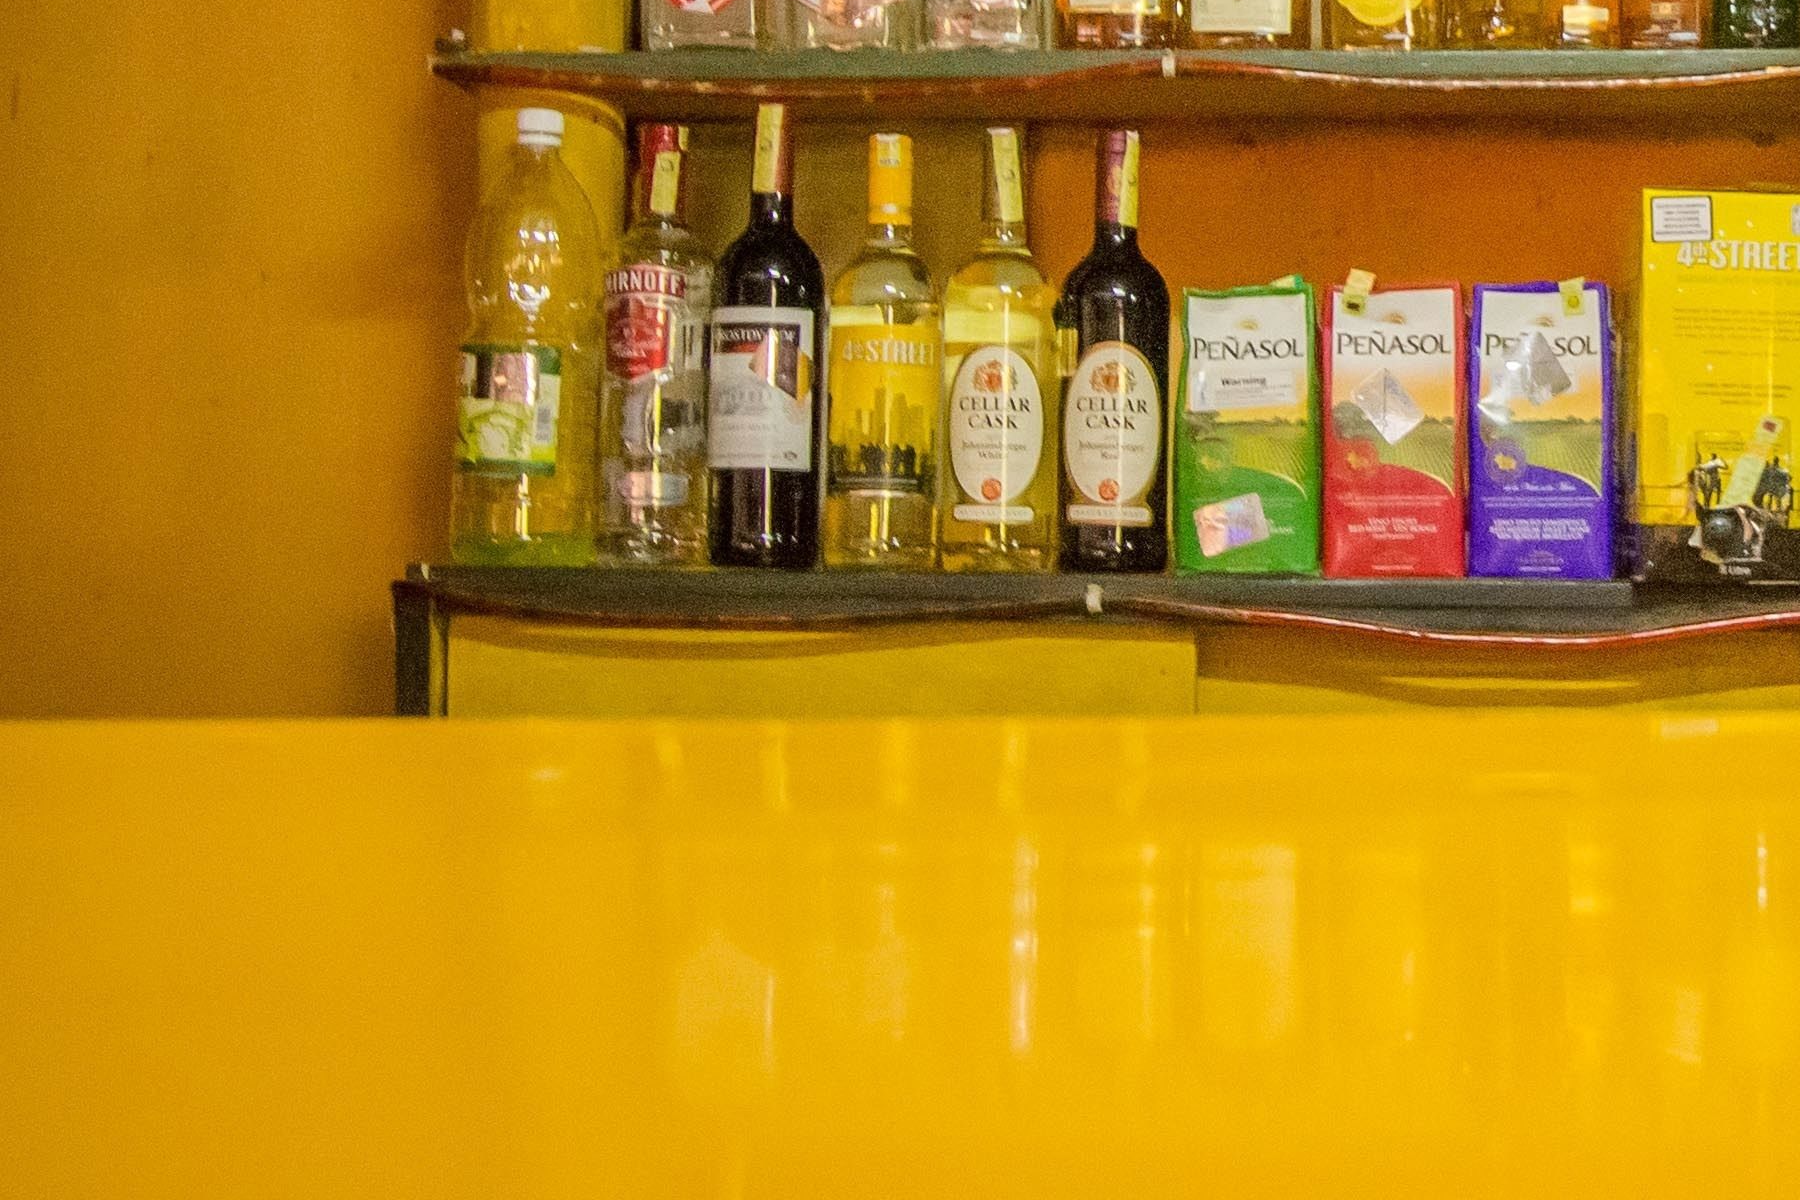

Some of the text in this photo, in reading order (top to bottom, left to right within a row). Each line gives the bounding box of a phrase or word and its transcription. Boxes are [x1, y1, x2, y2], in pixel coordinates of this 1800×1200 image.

[1676, 241, 1709, 268] 4th
[1193, 336, 1304, 361] PEÑASOL
[1335, 330, 1453, 356] PEÑASOL
[1484, 332, 1599, 357] PESOL
[959, 396, 1032, 414] CELLAR
[1075, 396, 1149, 414] CELLAR
[967, 413, 1020, 430] CASK
[1084, 413, 1137, 431] CASK
